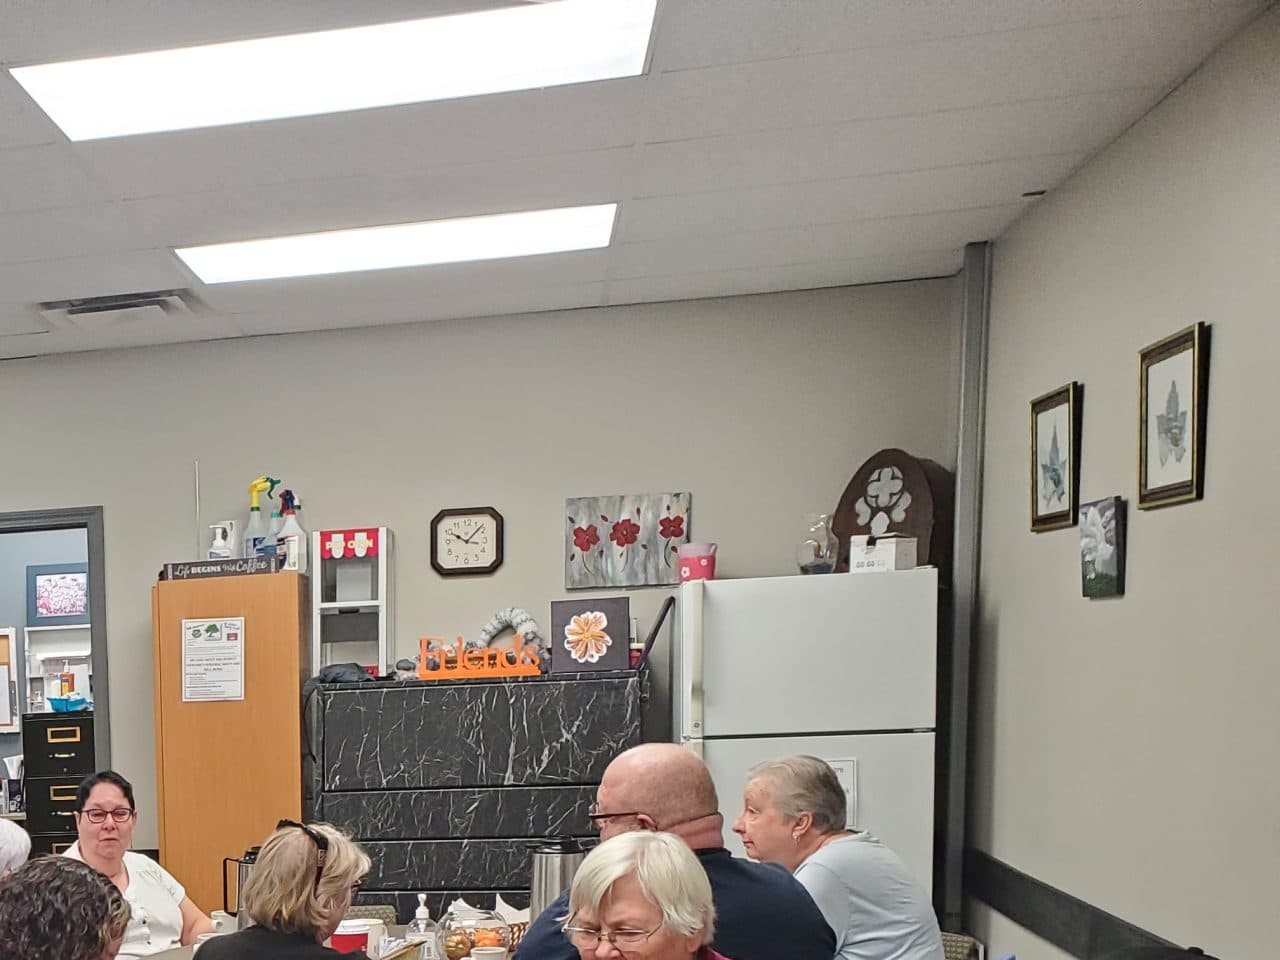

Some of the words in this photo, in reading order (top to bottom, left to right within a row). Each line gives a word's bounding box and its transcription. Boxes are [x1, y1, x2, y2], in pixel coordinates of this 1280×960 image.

[191, 565, 221, 574] BEGINS
[236, 559, 267, 573] Coffee
[419, 634, 541, 674] Friends
